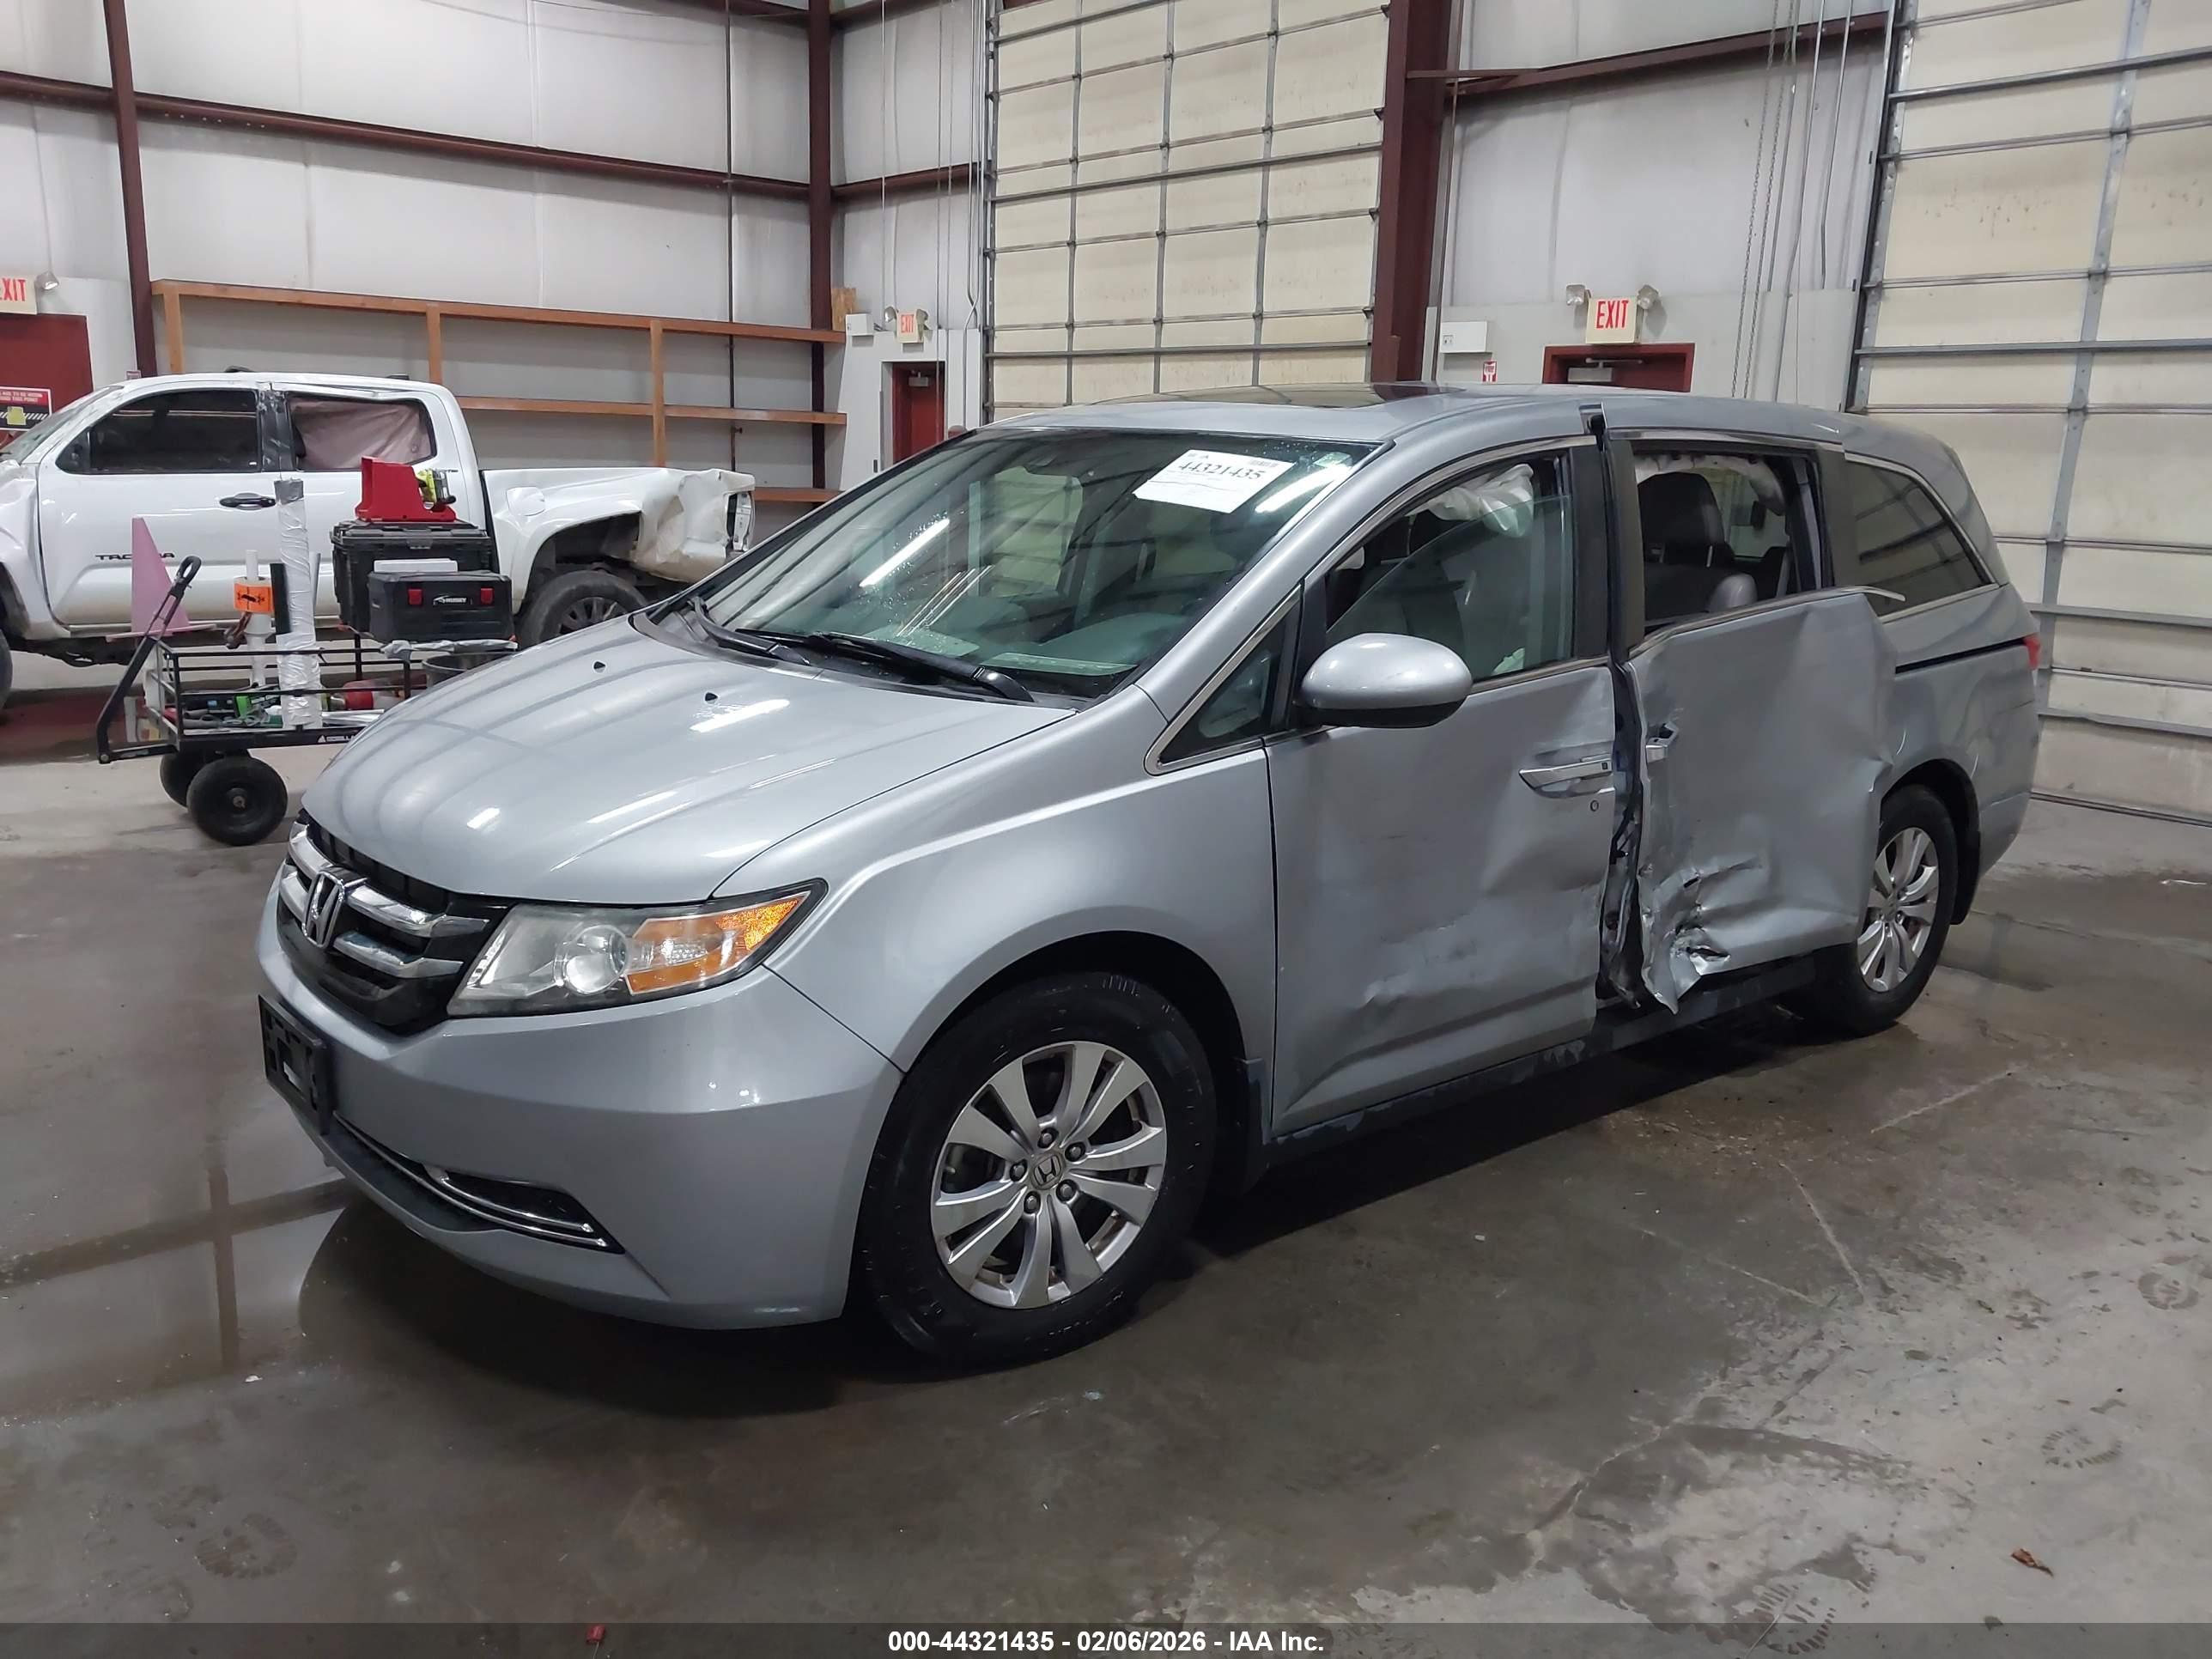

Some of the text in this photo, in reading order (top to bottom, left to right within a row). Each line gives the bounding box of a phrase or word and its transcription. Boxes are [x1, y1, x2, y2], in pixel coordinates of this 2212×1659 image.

[0, 277, 26, 302] XIT
[900, 313, 915, 333] EXIT
[1596, 300, 1629, 329] EXIT
[1179, 462, 1266, 480] 44321435
[94, 552, 175, 561] TACA
